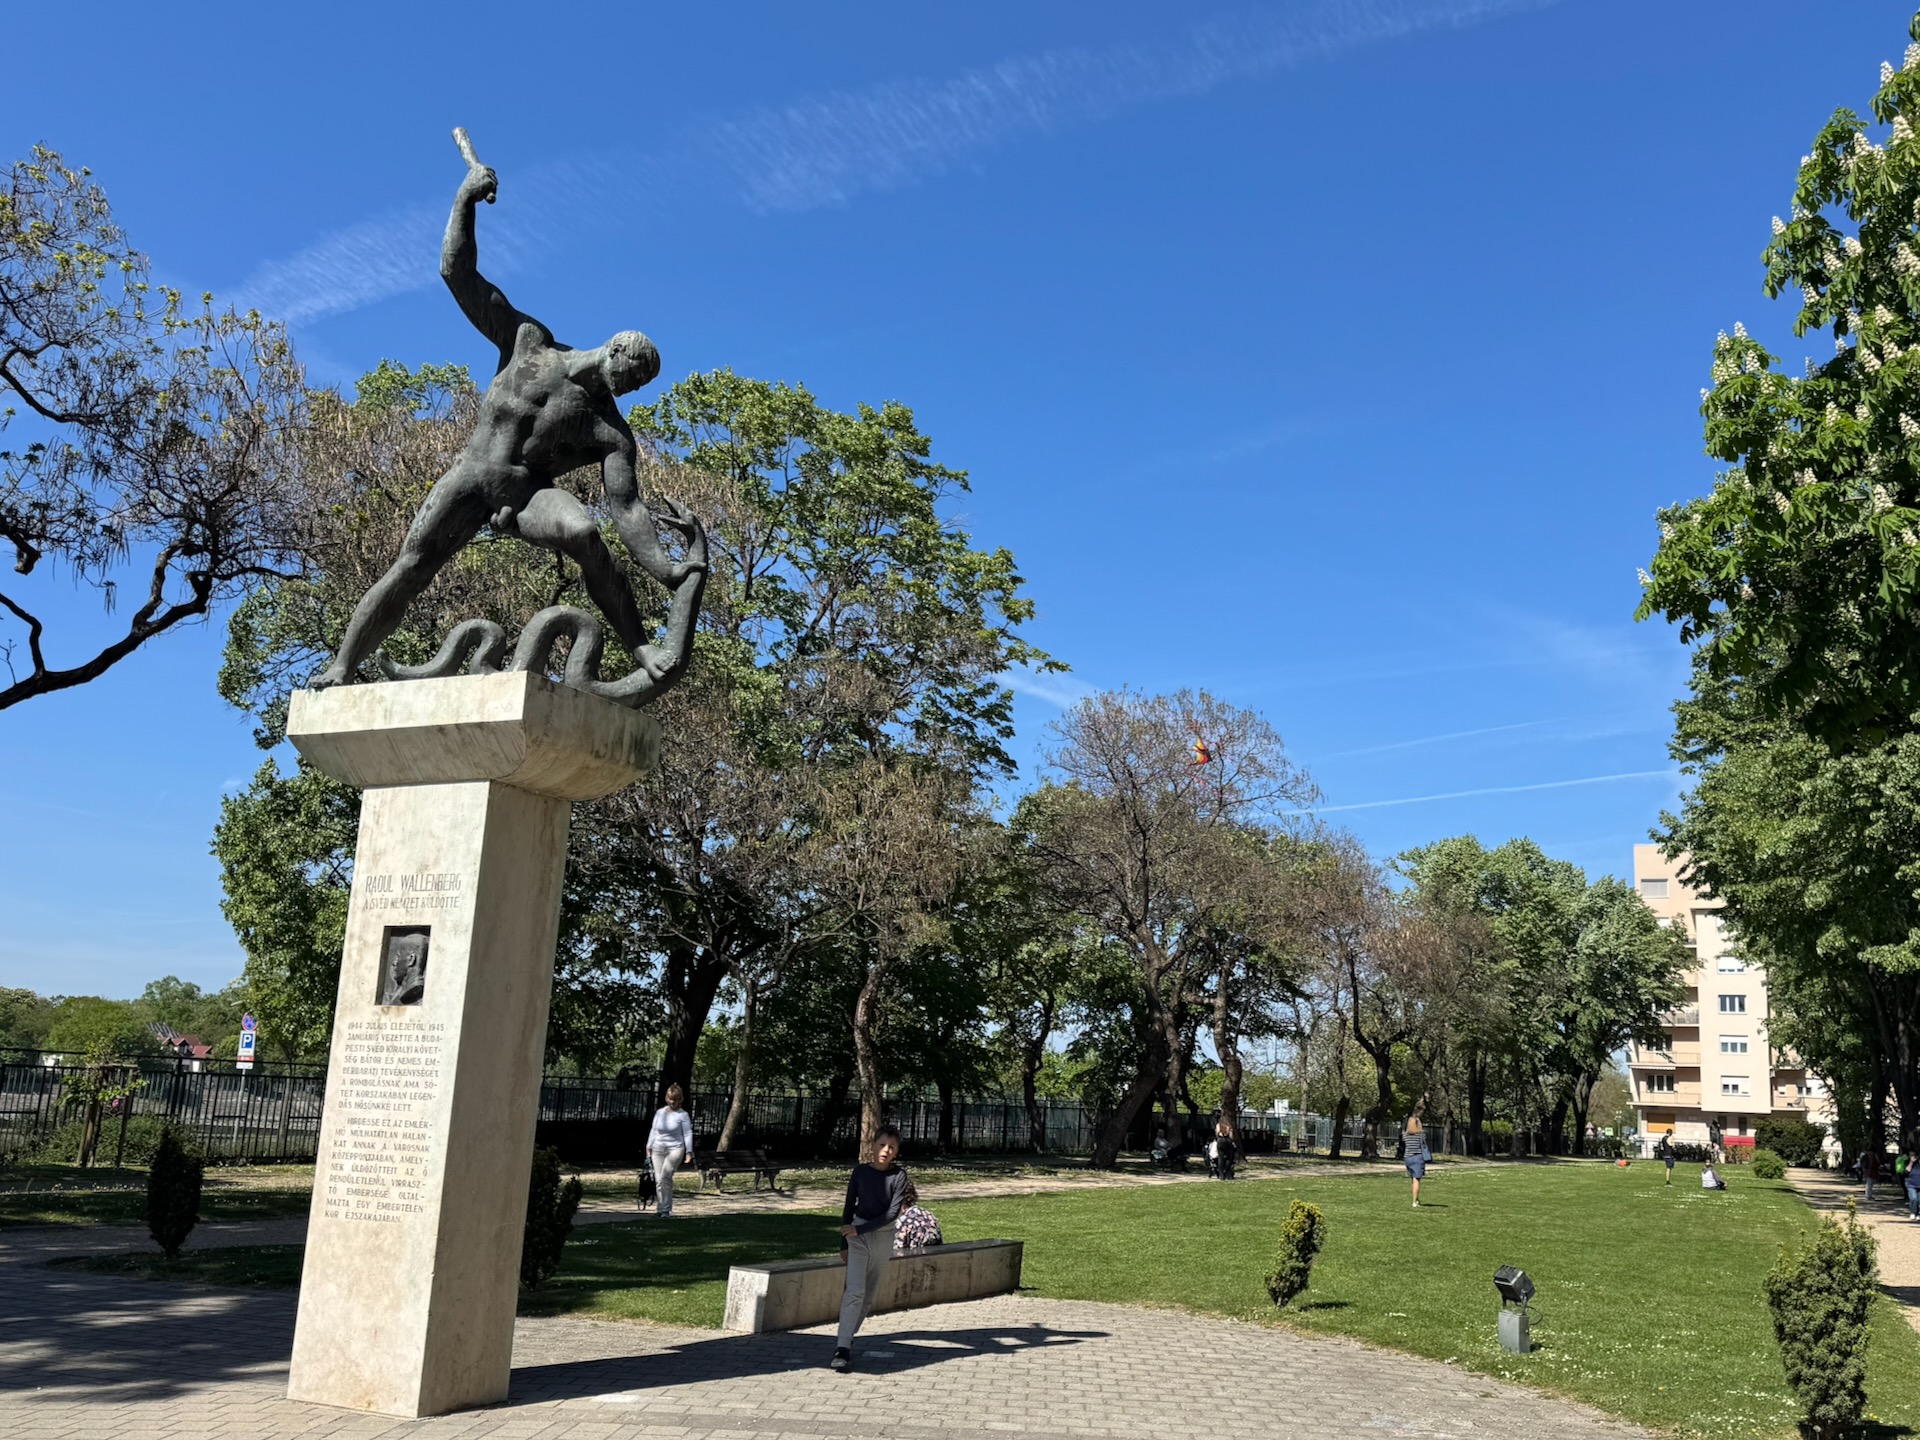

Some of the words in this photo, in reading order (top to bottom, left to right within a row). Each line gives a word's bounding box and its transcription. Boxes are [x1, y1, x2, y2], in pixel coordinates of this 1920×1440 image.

[365, 875, 393, 892] RAOUL
[401, 873, 462, 892] WALLENBERG
[429, 1023, 444, 1031] 1945
[242, 1034, 252, 1048] P
[382, 1034, 413, 1042] VEZETTE
[345, 1044, 365, 1052] PESTI
[366, 1042, 385, 1052] SVÉD
[360, 1054, 382, 1064] BÁTOR
[385, 1054, 394, 1065] ÉS
[397, 1057, 421, 1066] NEMES
[338, 1098, 352, 1109] DÁS
[382, 1119, 391, 1127] EZ
[393, 1120, 402, 1128] AZ
[334, 1140, 347, 1148] KAT
[352, 1141, 376, 1149] ANNAK
[330, 1163, 344, 1171] NEK
[405, 1168, 414, 1176] AZ
[326, 1198, 350, 1207] MAZTA
[356, 1200, 371, 1209] EGY
[377, 1202, 424, 1213] EMBERTELEN
[325, 1210, 339, 1218] KOR
